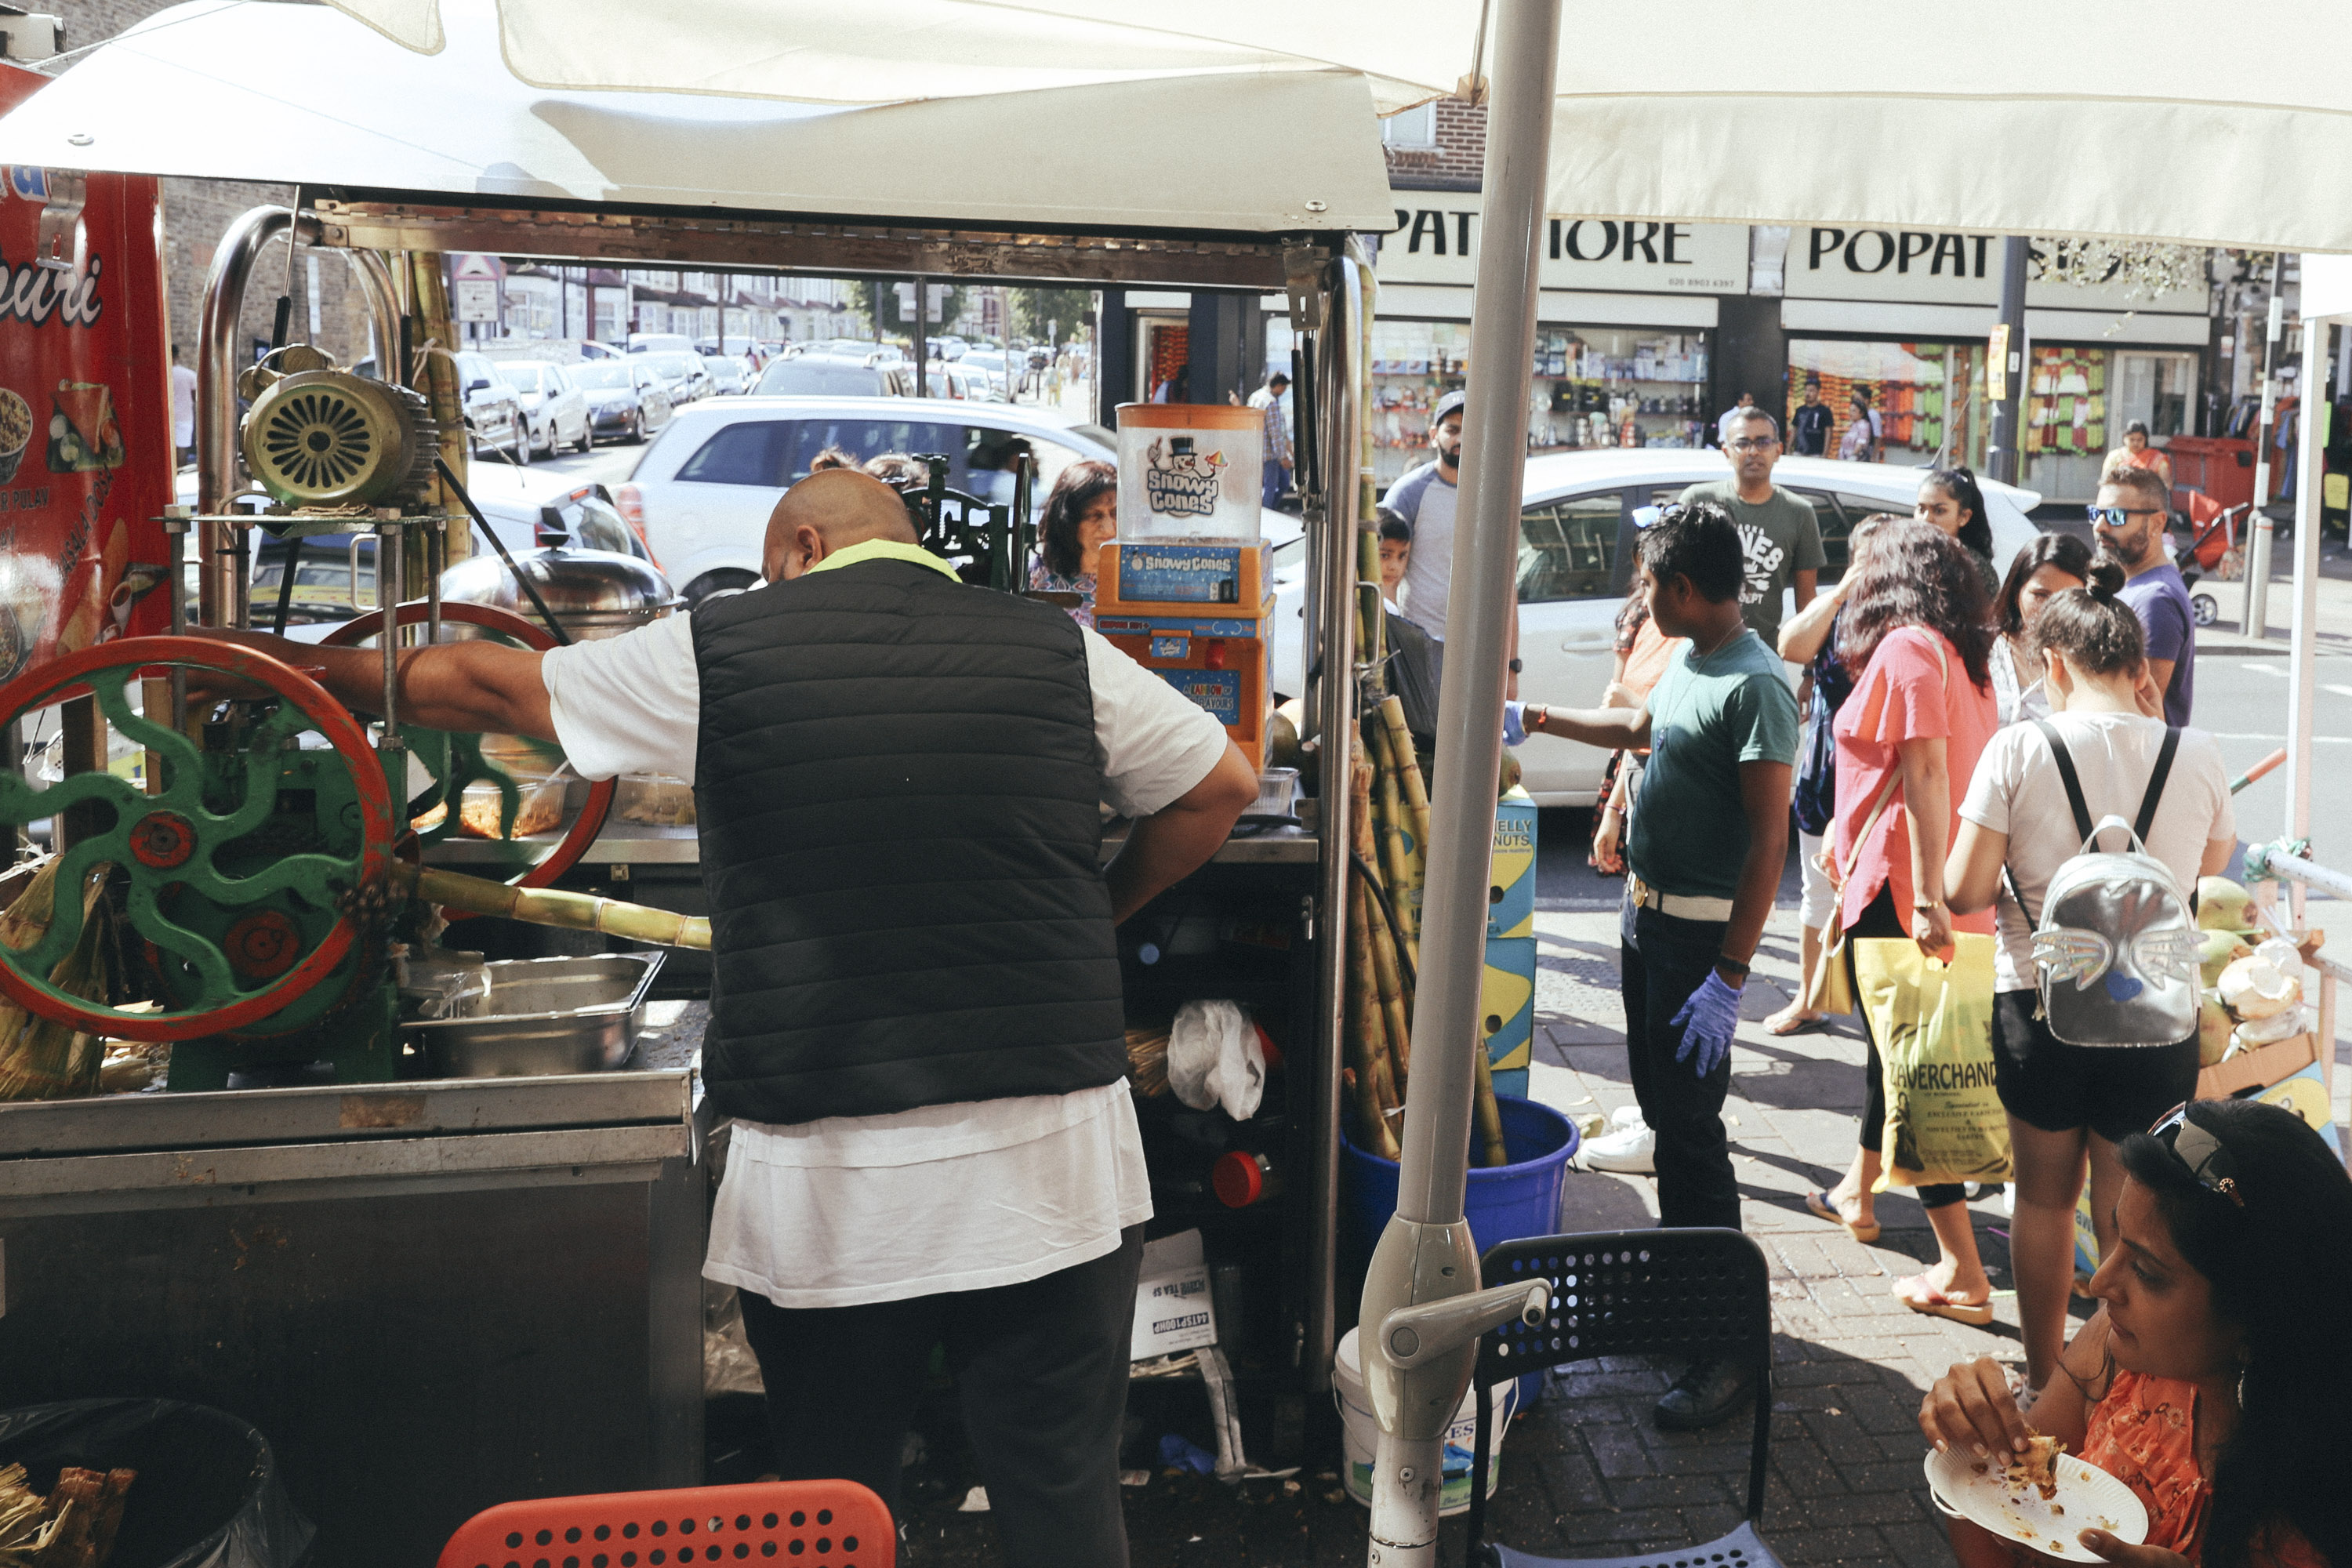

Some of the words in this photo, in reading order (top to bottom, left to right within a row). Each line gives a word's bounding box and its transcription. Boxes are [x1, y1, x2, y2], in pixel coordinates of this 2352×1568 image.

[1809, 227, 1996, 278] POPAT
[86, 461, 115, 524] DOSA
[1148, 469, 1218, 497] Snowy
[13, 487, 49, 510] PULAV
[1150, 489, 1214, 515] Cones
[1145, 556, 1191, 572] Snowy
[1192, 557, 1232, 572] Cones
[1496, 819, 1532, 833] ELLY
[1494, 834, 1530, 846] NUTS
[1163, 1283, 1179, 1294] TEA
